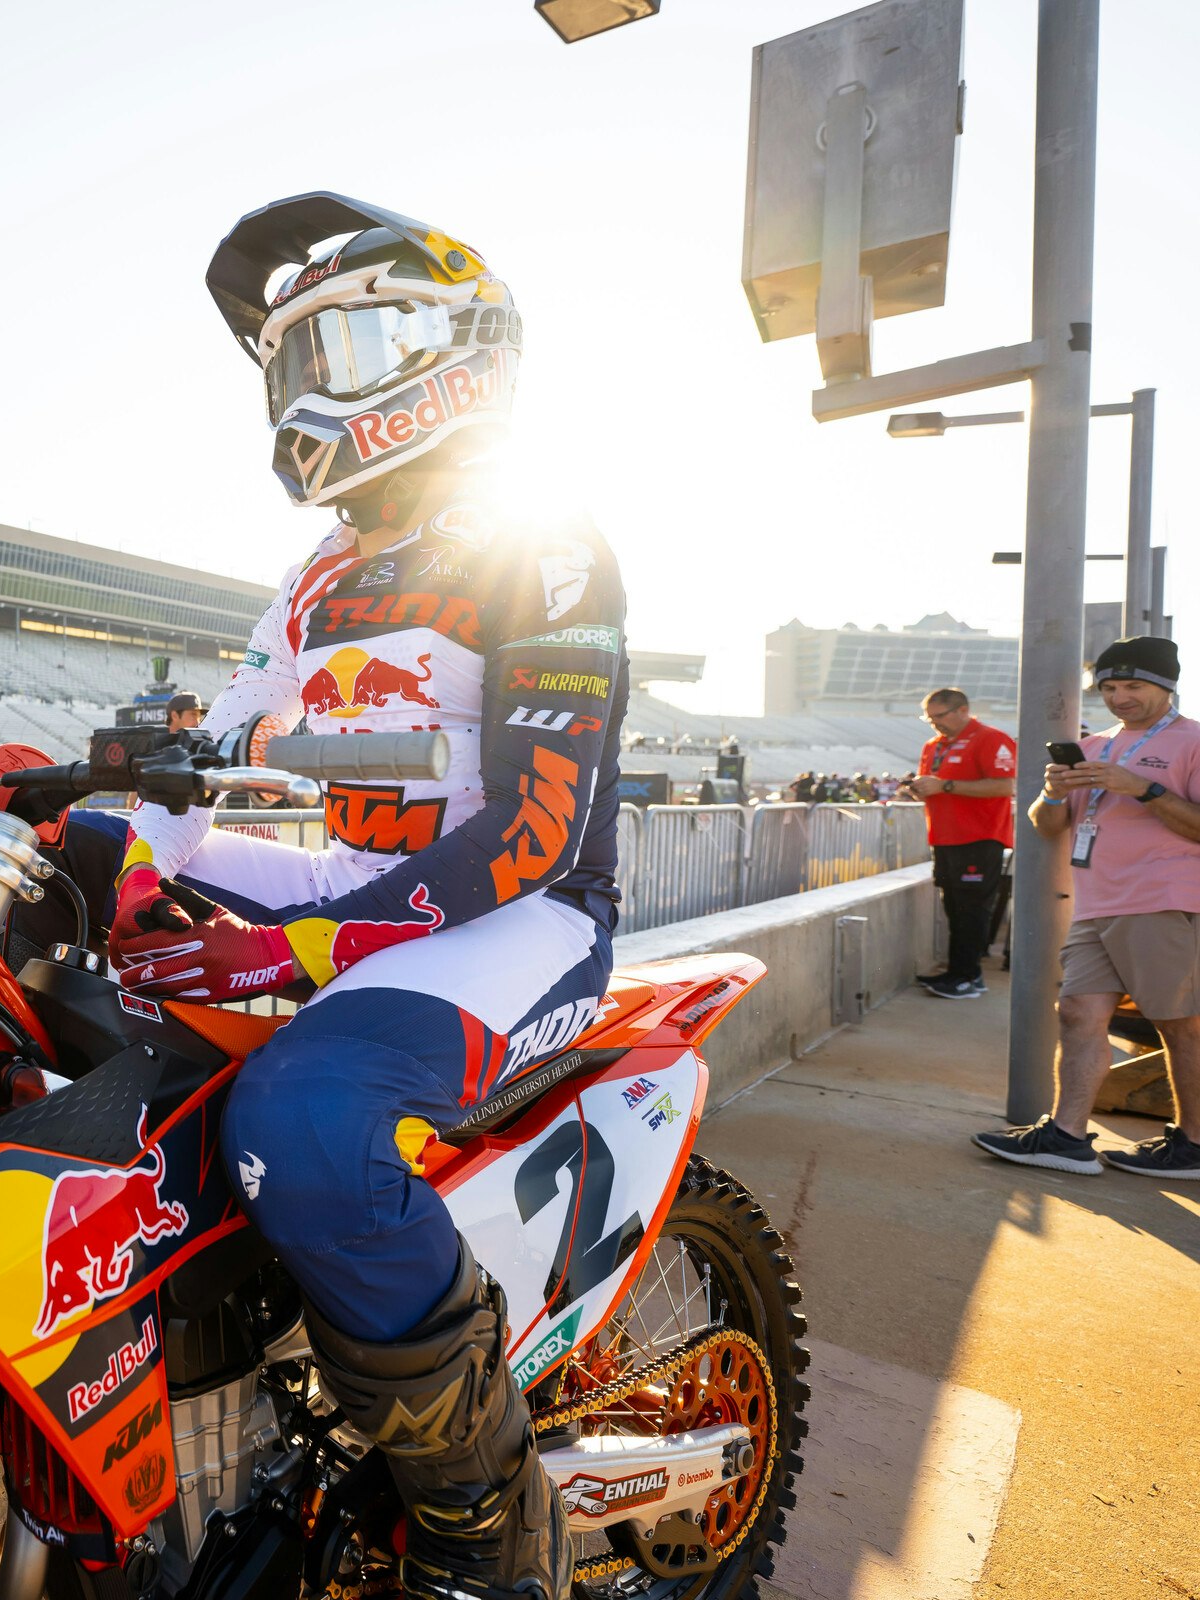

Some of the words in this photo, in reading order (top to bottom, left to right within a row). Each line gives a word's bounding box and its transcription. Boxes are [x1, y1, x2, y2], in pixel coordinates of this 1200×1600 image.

[345, 377, 447, 462] Red
[355, 577, 394, 589] RENTHAL
[325, 593, 483, 646] THOR
[134, 707, 168, 722] FINIS
[323, 783, 445, 854] KTM
[489, 745, 579, 905] KTM
[229, 965, 280, 989] THOR
[476, 1099, 505, 1122] LINDA
[504, 1070, 552, 1110] UNIVERSITY
[551, 1054, 583, 1080] HEALTH
[621, 1077, 657, 1109] AMA
[514, 1120, 646, 1318] 2
[68, 1353, 120, 1424] Red
[117, 1314, 157, 1382] Bull
[102, 1398, 162, 1474] KTM
[686, 1468, 714, 1485] brembo
[22, 1508, 46, 1539] Twin
[45, 1525, 67, 1544] Air
